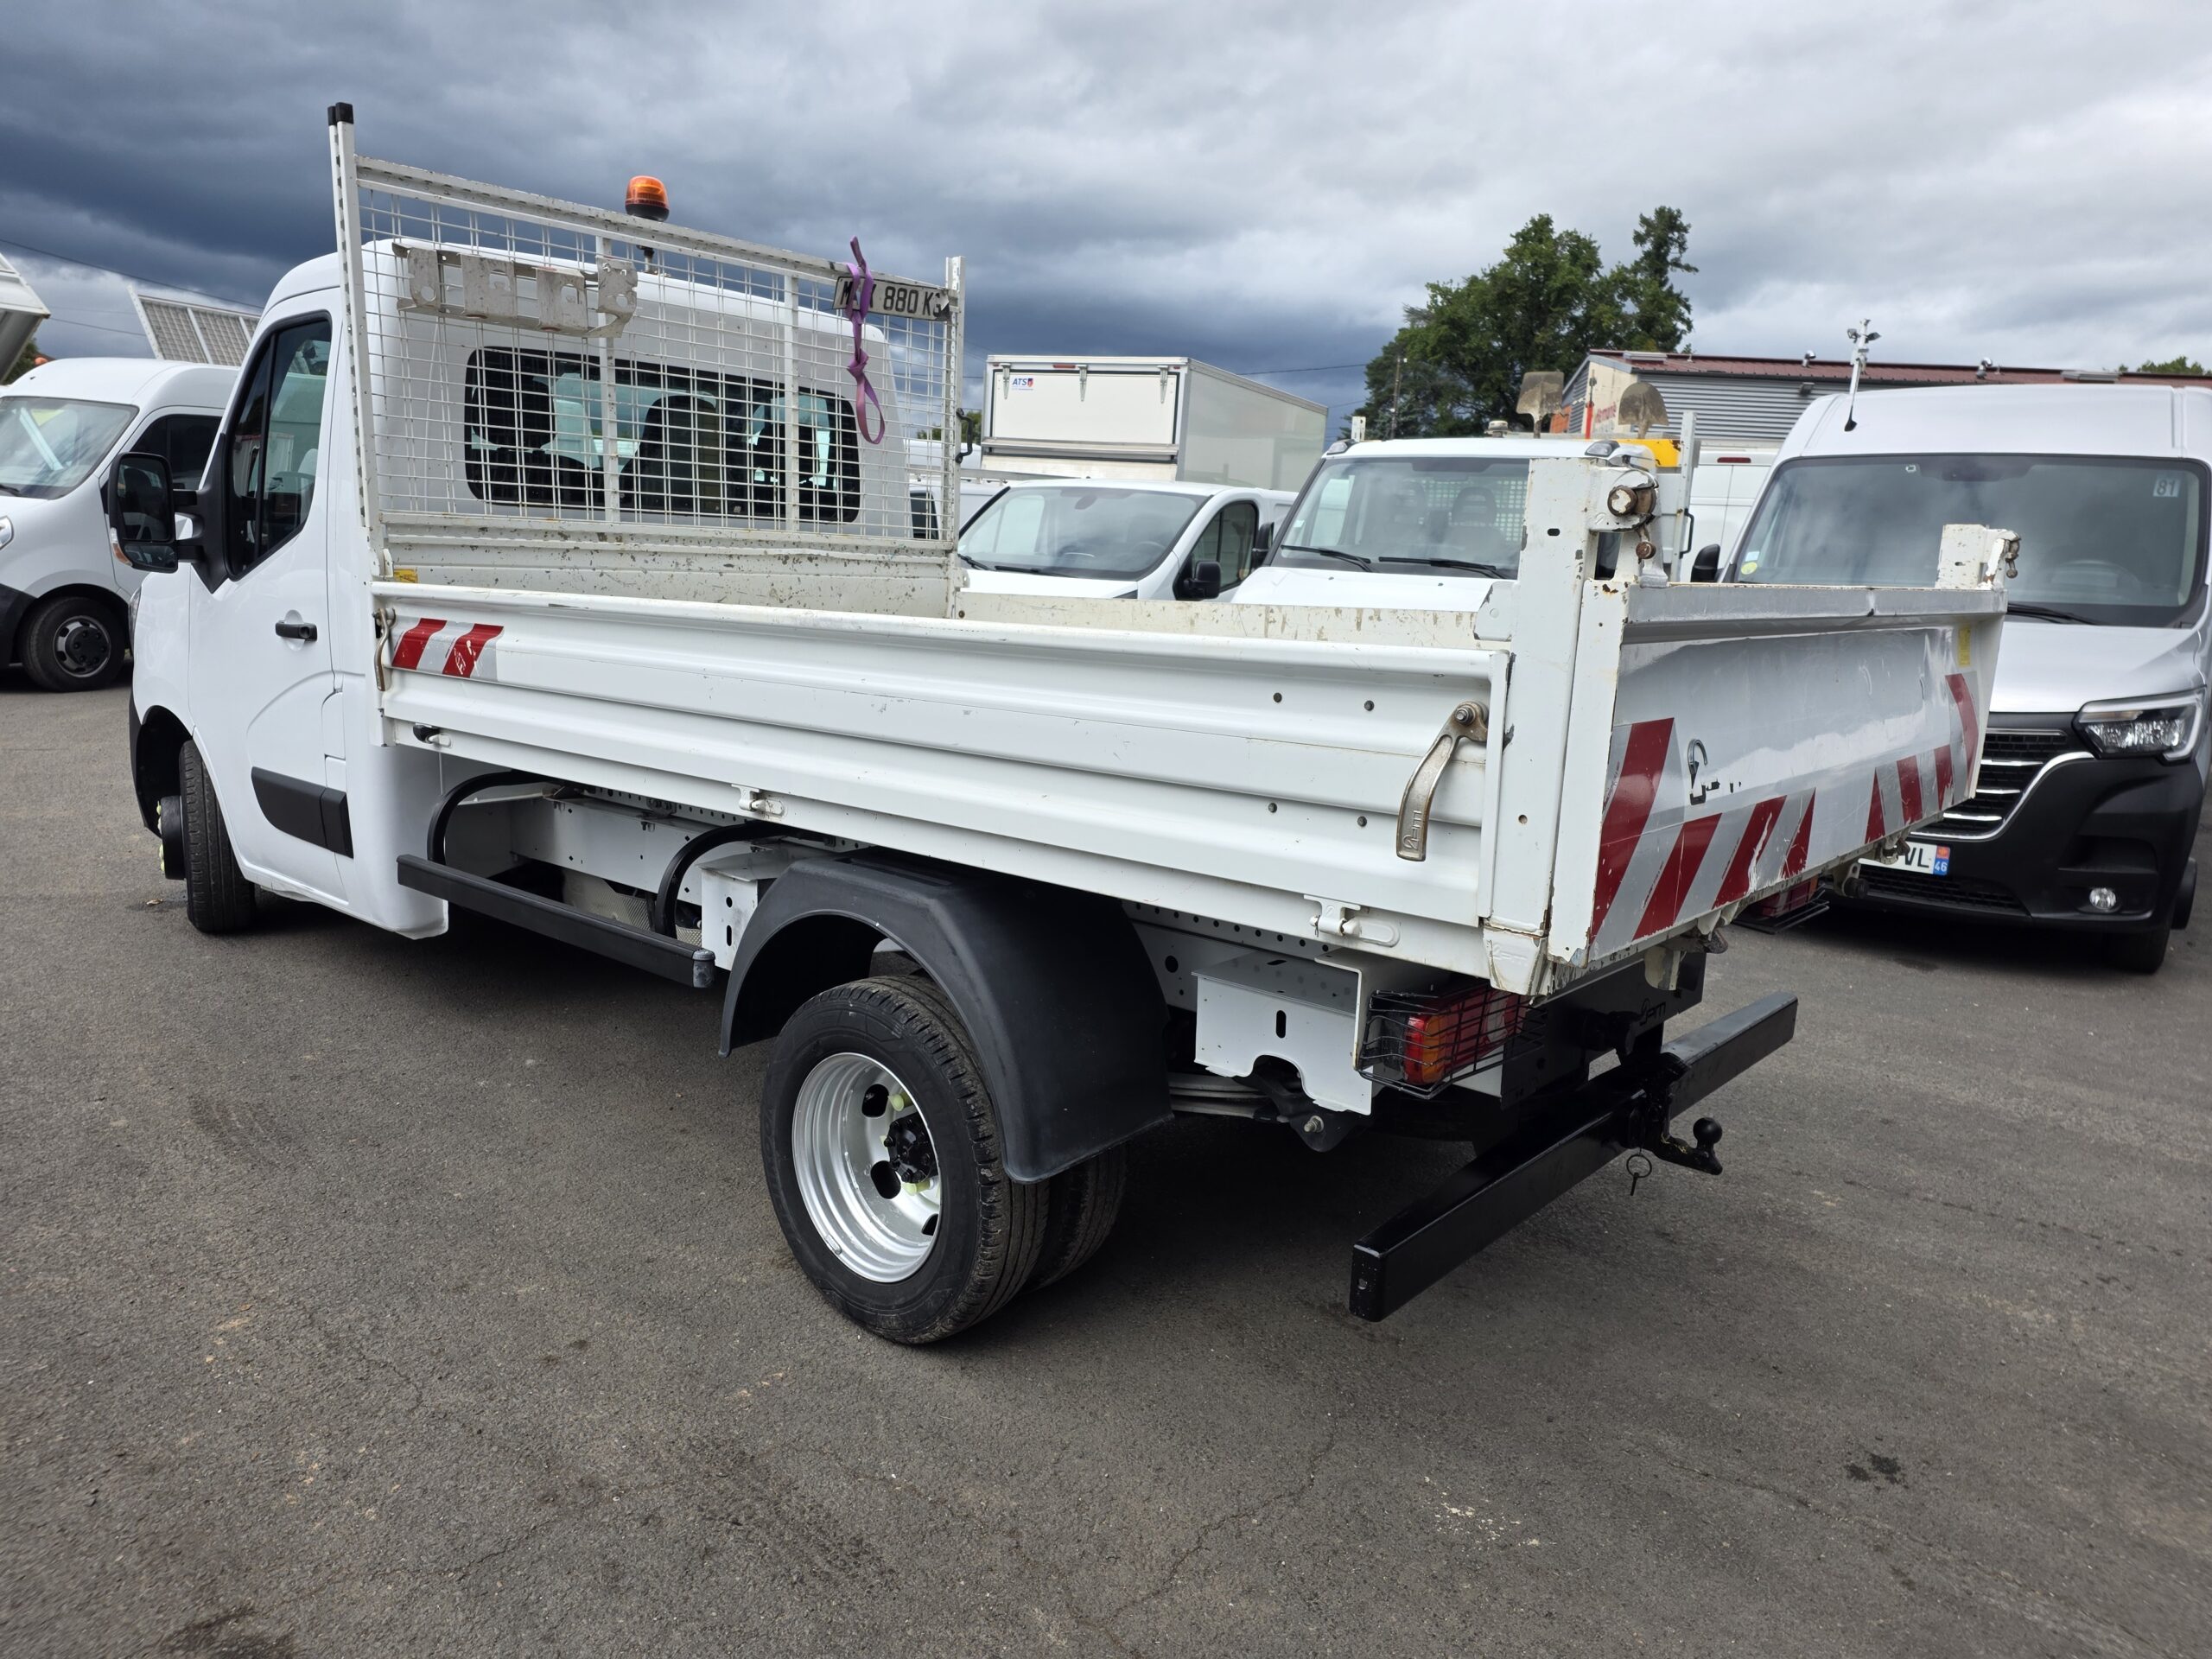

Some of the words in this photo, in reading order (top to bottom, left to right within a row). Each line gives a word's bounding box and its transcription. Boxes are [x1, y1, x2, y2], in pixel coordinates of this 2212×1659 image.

[883, 286, 919, 314] 880
[2156, 480, 2176, 496] 81
[1935, 861, 1948, 872] 46
